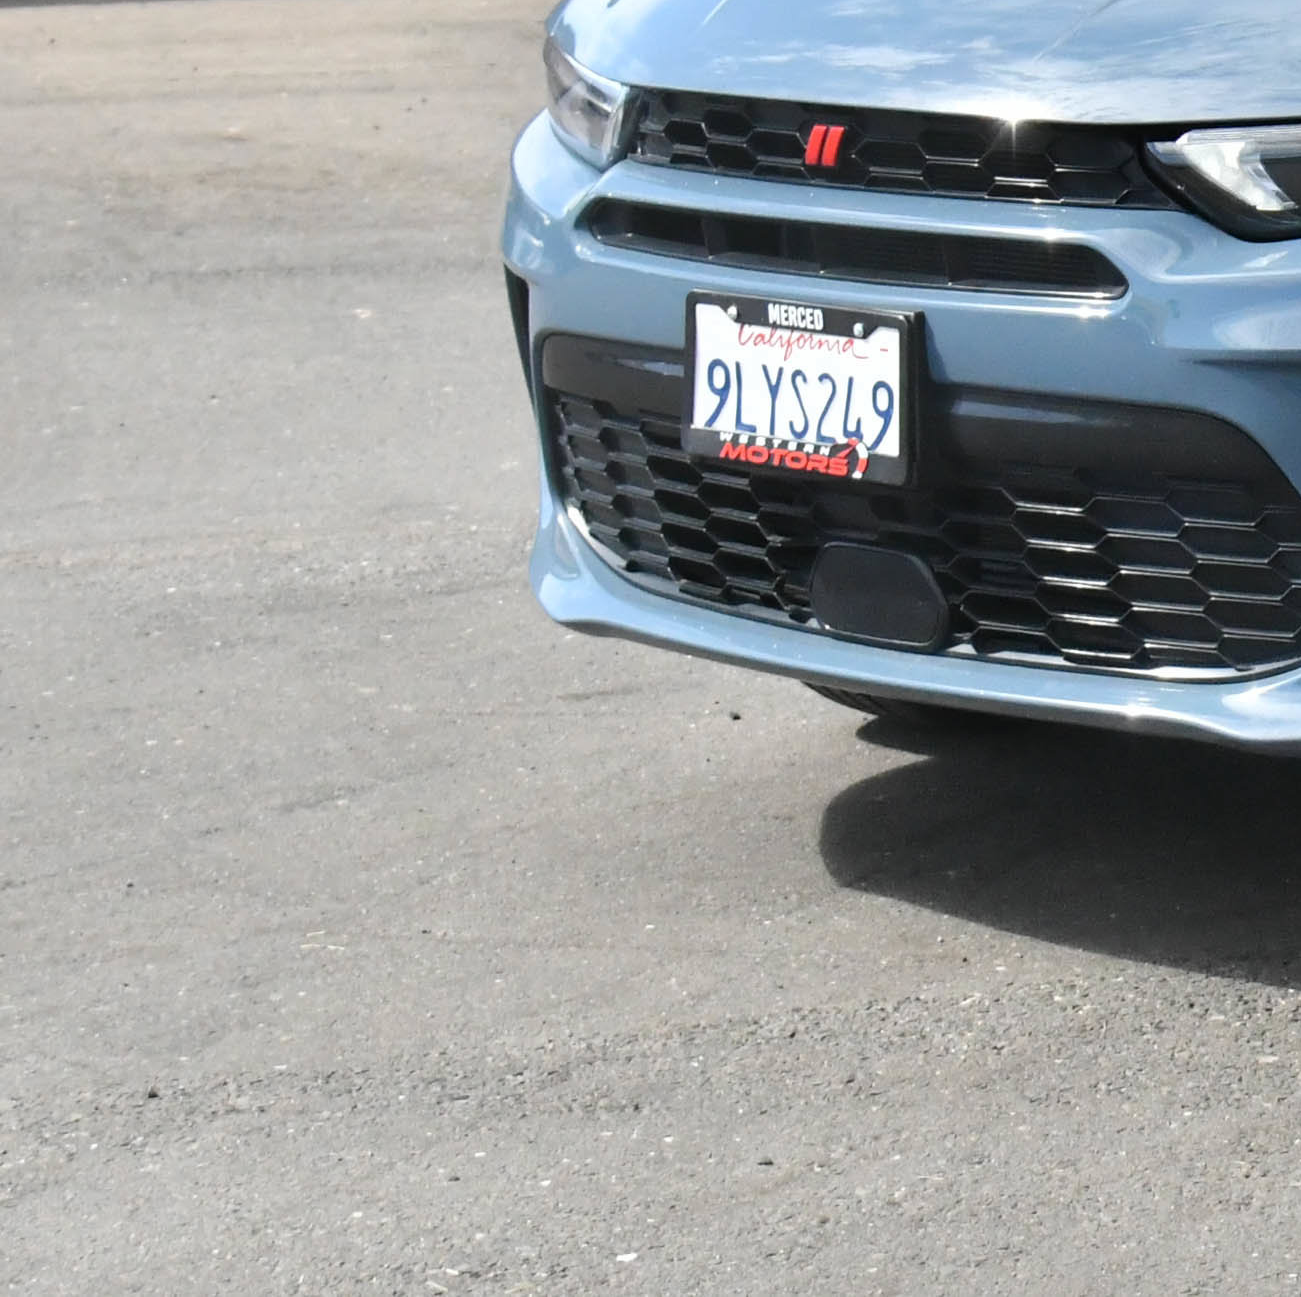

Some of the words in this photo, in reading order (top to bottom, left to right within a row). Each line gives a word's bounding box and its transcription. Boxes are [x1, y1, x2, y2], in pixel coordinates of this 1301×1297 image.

[767, 303, 824, 331] MERCED
[738, 322, 869, 362] California
[704, 358, 894, 452] 9LYS249
[719, 441, 849, 477] MOTORS
